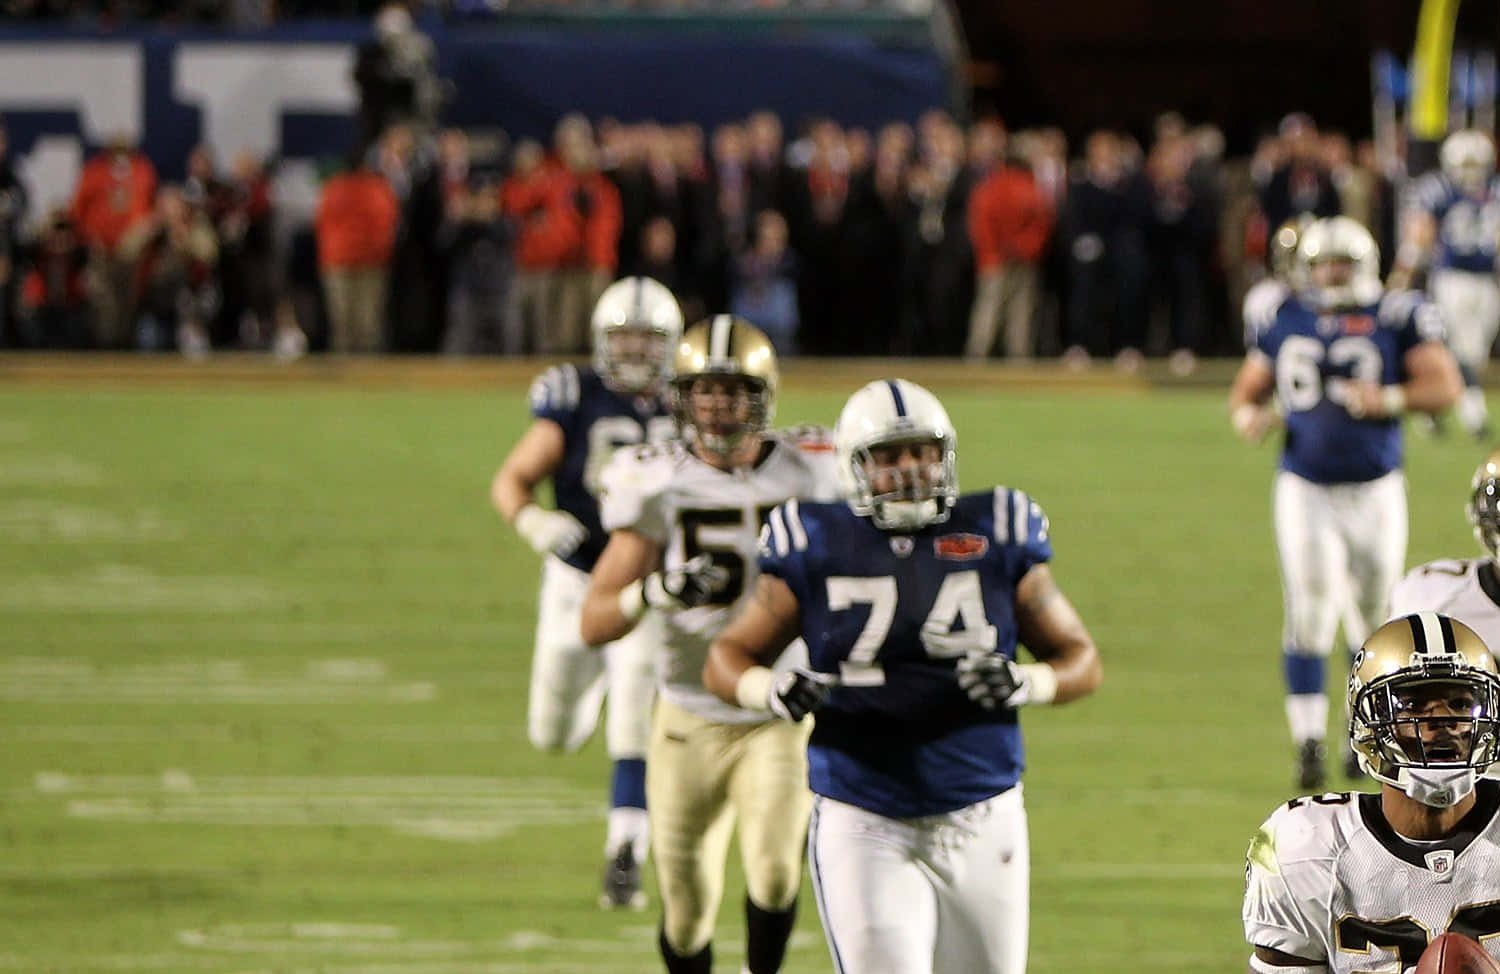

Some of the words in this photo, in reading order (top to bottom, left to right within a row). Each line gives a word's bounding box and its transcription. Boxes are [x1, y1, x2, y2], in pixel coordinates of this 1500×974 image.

[1276, 335, 1382, 411] 63
[678, 505, 775, 607] 5
[825, 570, 997, 687] 74
